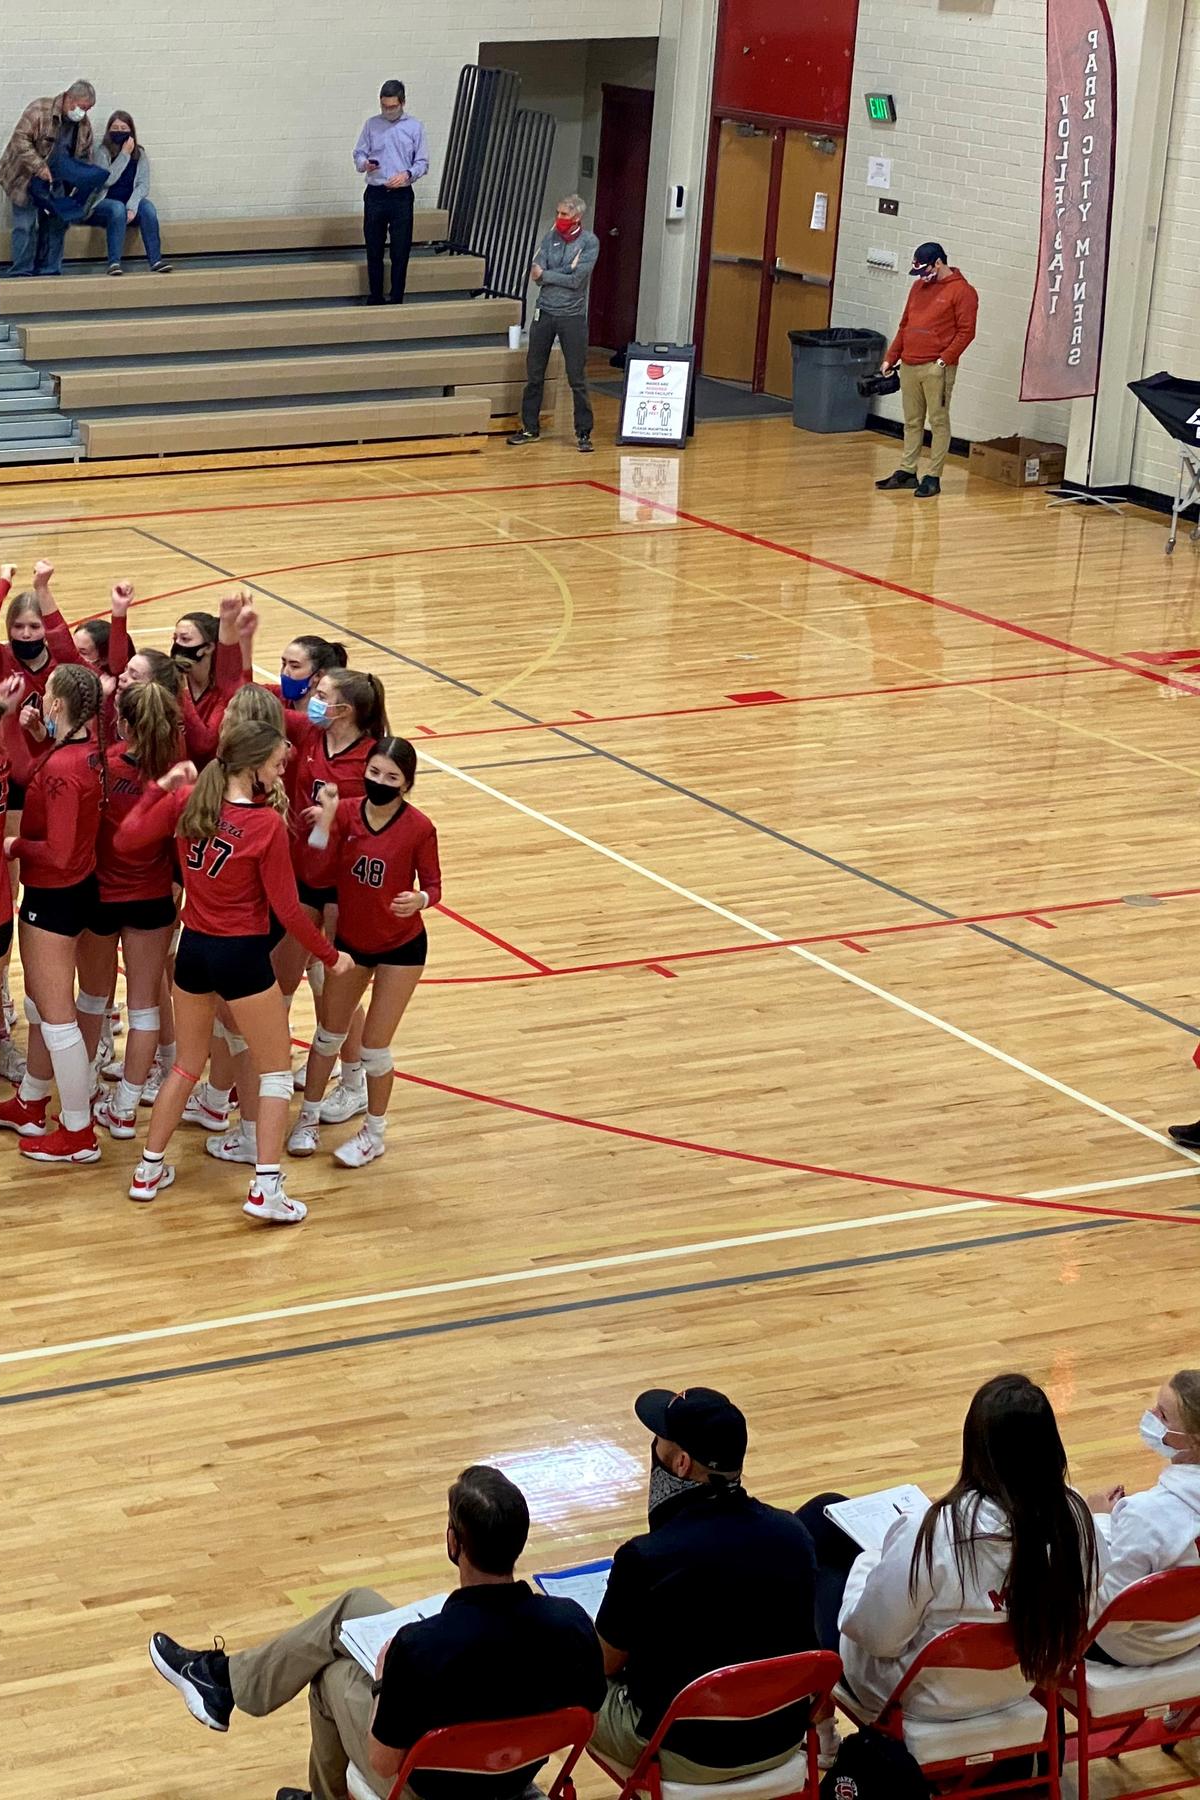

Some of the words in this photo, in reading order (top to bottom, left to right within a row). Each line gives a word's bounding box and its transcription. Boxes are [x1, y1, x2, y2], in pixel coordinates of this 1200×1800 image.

[869, 97, 888, 119] EXIT
[185, 836, 234, 879] 37
[351, 855, 386, 888] 48
